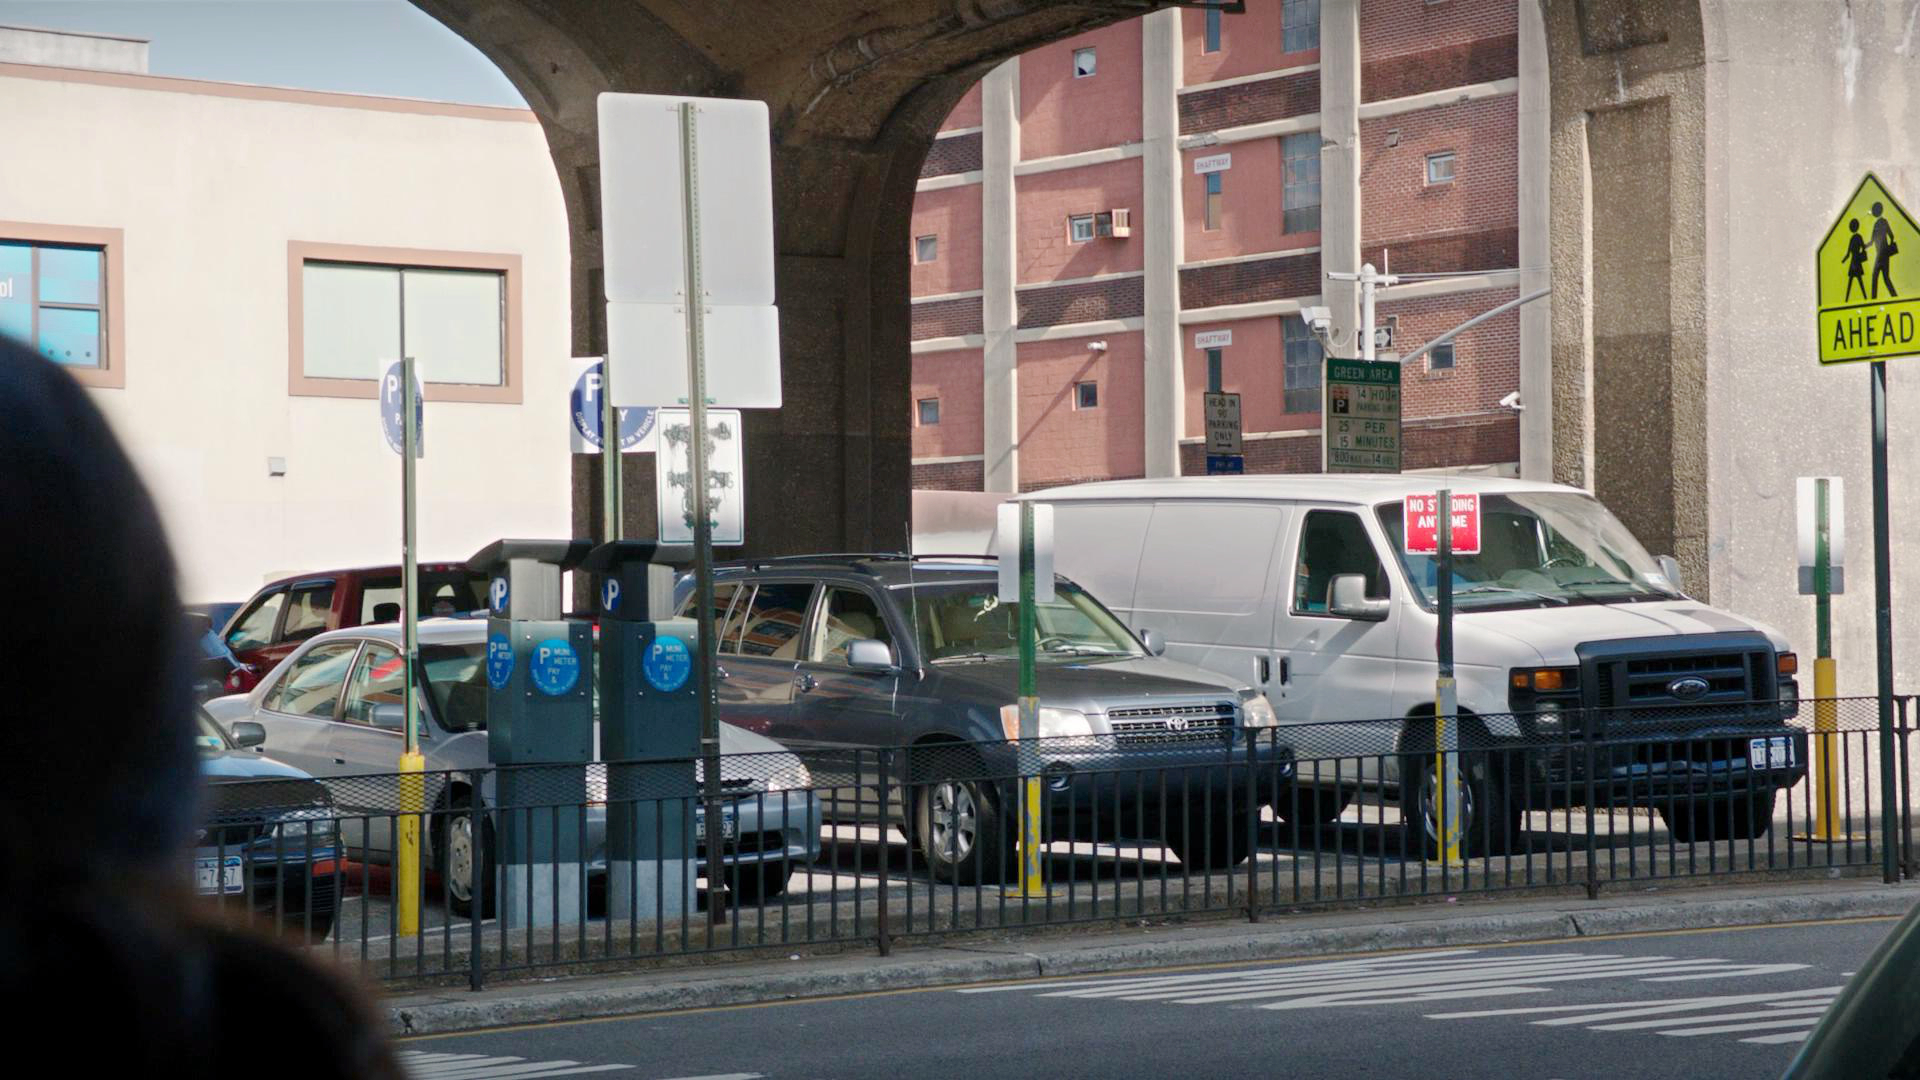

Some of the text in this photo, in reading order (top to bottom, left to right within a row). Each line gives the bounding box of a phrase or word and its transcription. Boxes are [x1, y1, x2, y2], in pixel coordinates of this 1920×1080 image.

[1833, 312, 1914, 351] AHEAD
[1334, 366, 1393, 380] GREEN AREA
[586, 373, 604, 402] P
[1371, 389, 1397, 401] HOUR
[1209, 398, 1236, 408] HEAD IN
[1208, 420, 1239, 431] PARKING
[1365, 422, 1386, 433] PER
[1214, 431, 1233, 441] ONLY
[1339, 435, 1395, 449] 15 MINUTES
[1409, 498, 1474, 513] NO SDING
[1417, 515, 1468, 529] ANME
[540, 648, 551, 665] P
[652, 644, 662, 661] P
[554, 657, 577, 666] METER
